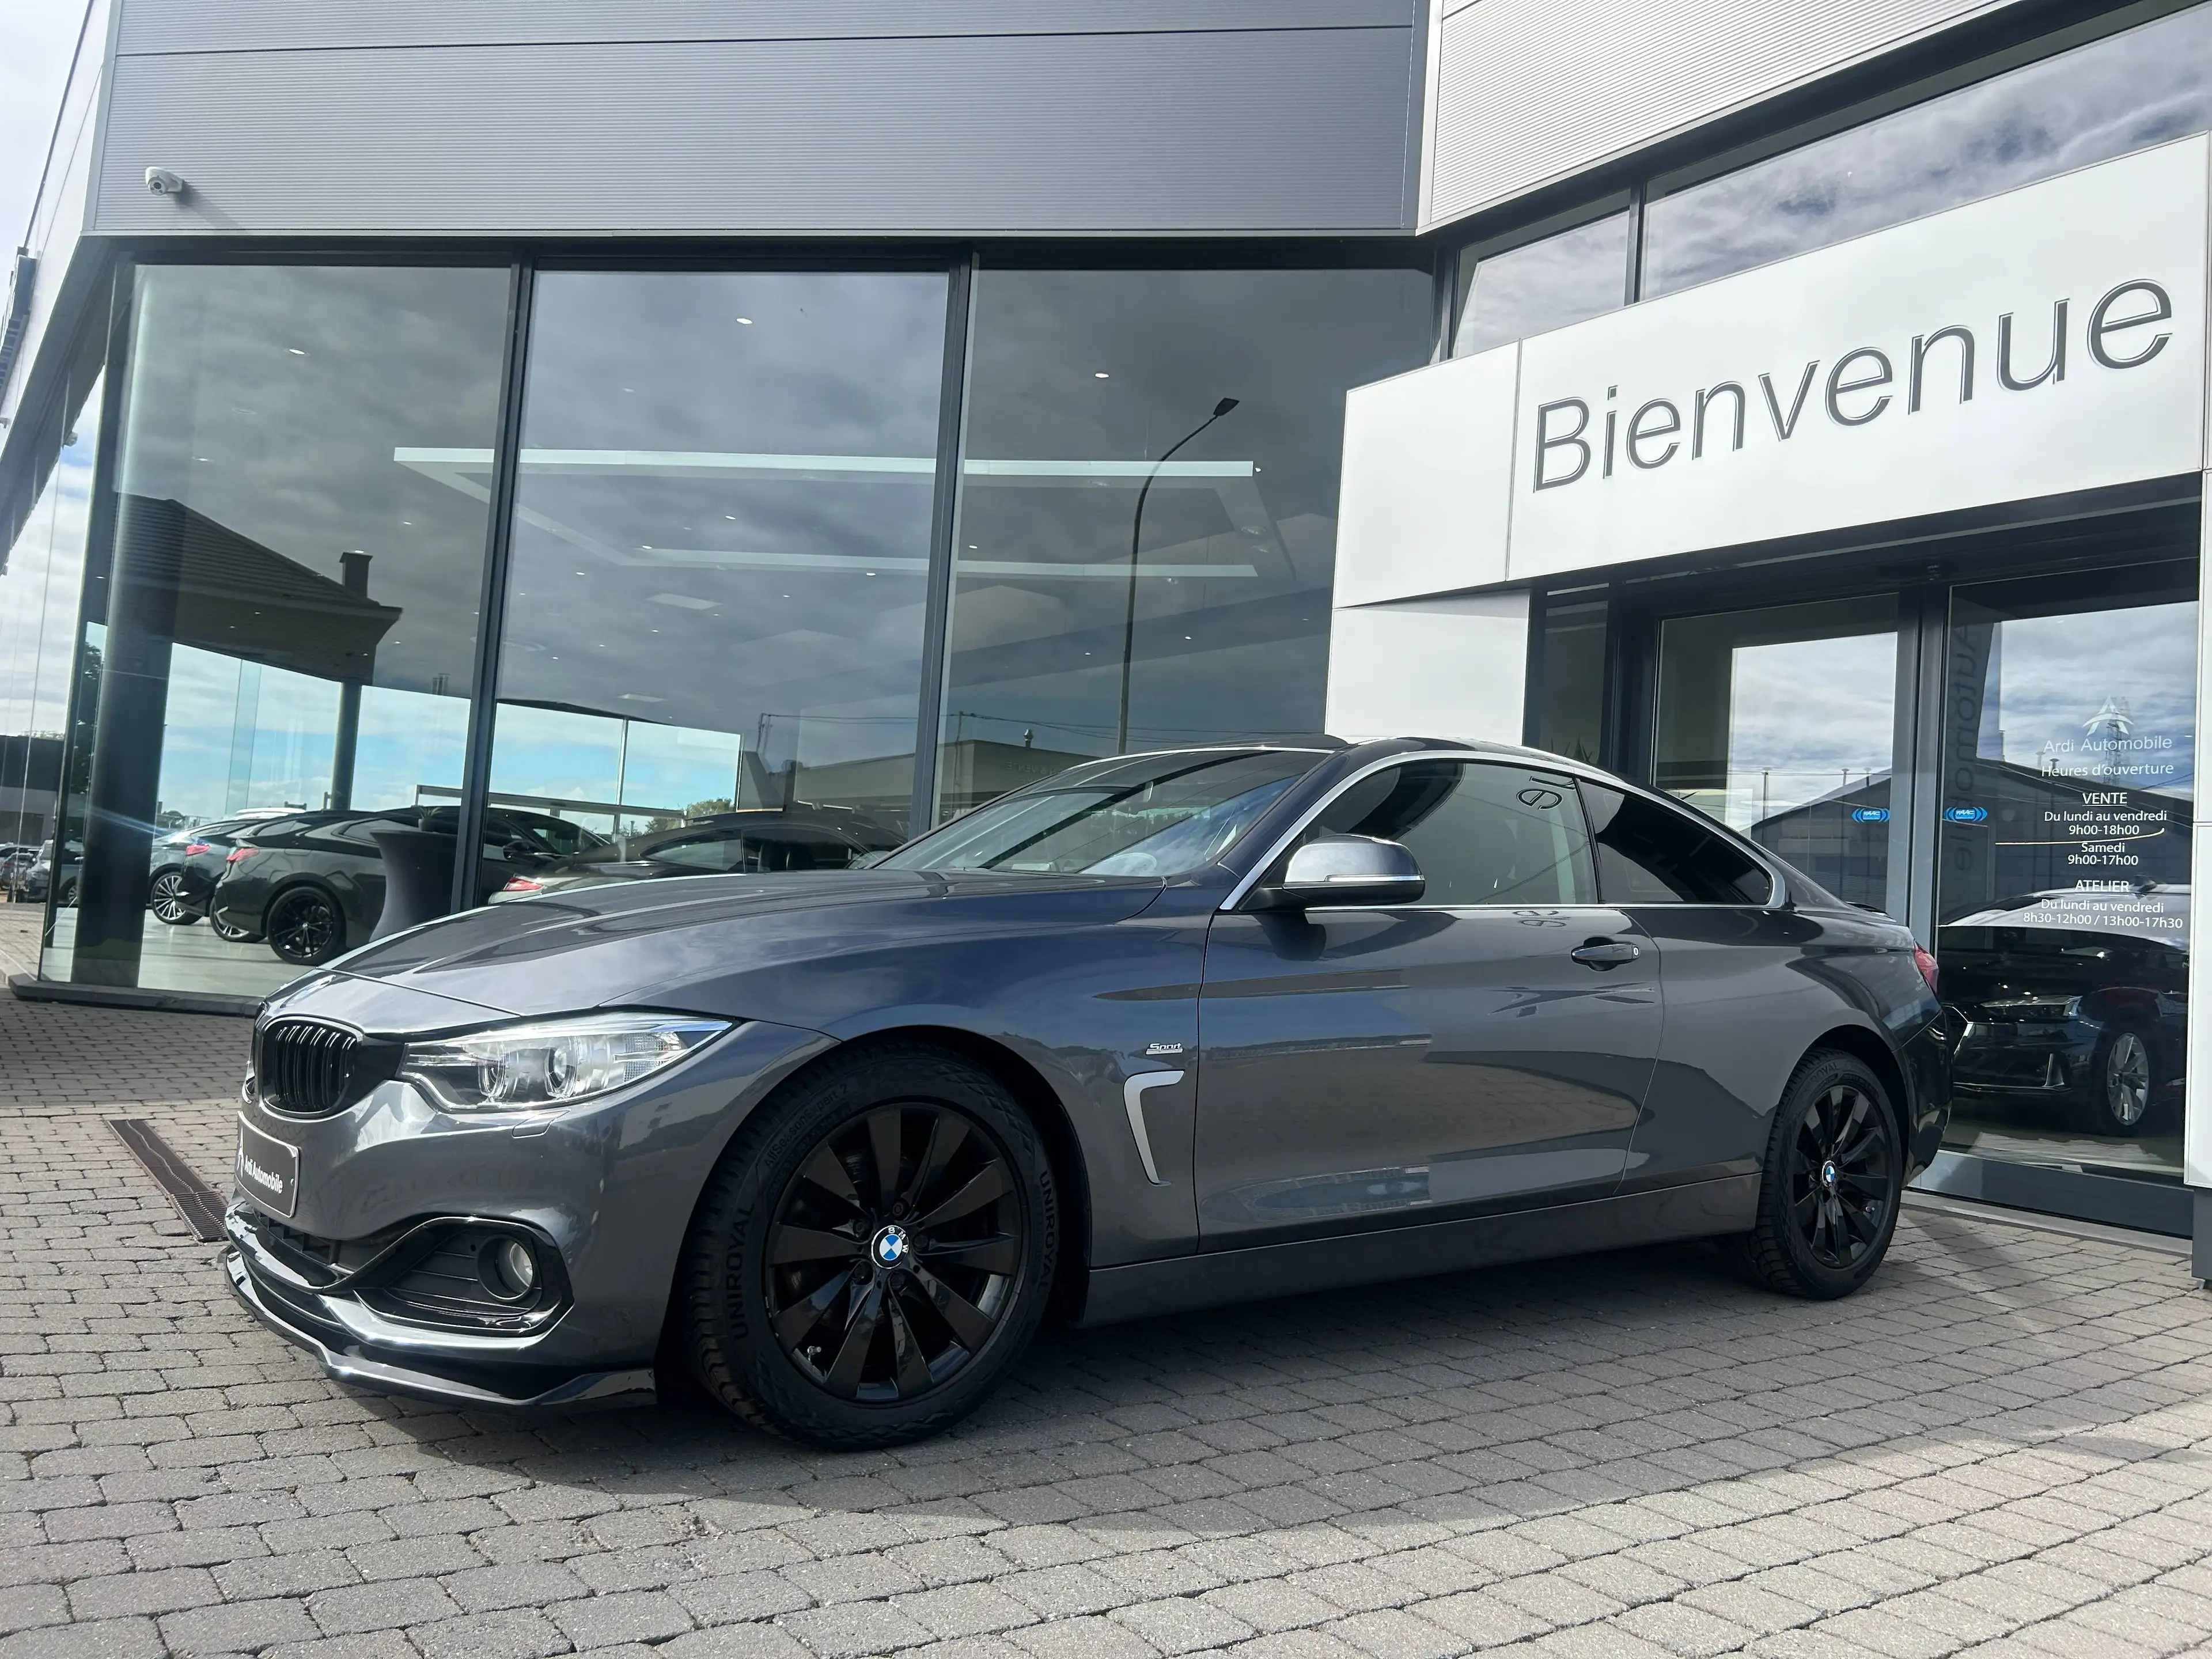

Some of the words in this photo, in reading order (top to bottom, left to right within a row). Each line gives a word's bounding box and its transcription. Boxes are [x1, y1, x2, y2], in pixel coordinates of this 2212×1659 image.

[1533, 278, 2173, 493] Bienvenue
[2043, 739, 2074, 752] Ardi
[2081, 735, 2173, 752] Automobile
[2041, 766, 2088, 777] Heures
[2092, 764, 2174, 776] d'ouverture
[2082, 792, 2127, 805] VENTE
[2044, 812, 2061, 821] Du
[2064, 811, 2093, 821] lundi
[2096, 812, 2110, 821] au
[2113, 810, 2167, 821] vendredi
[2069, 824, 2139, 835] 9h00-18h00
[2081, 842, 2125, 853] Samedi
[2067, 854, 2139, 865] 9h00-17h00
[2074, 880, 2130, 892] ATELIER
[2041, 899, 2057, 909] Du
[2061, 899, 2090, 911] lundi
[2093, 903, 2107, 911] au
[2110, 902, 2164, 913] vendredi
[2023, 912, 2092, 925] 8h30-12h00
[2094, 915, 2100, 925] /
[2103, 915, 2183, 929] 13h00-17h30
[252, 1161, 283, 1194] Automobile
[1036, 1170, 1055, 1293] UNIROYAL
[725, 1202, 755, 1341] UNIROYAL
